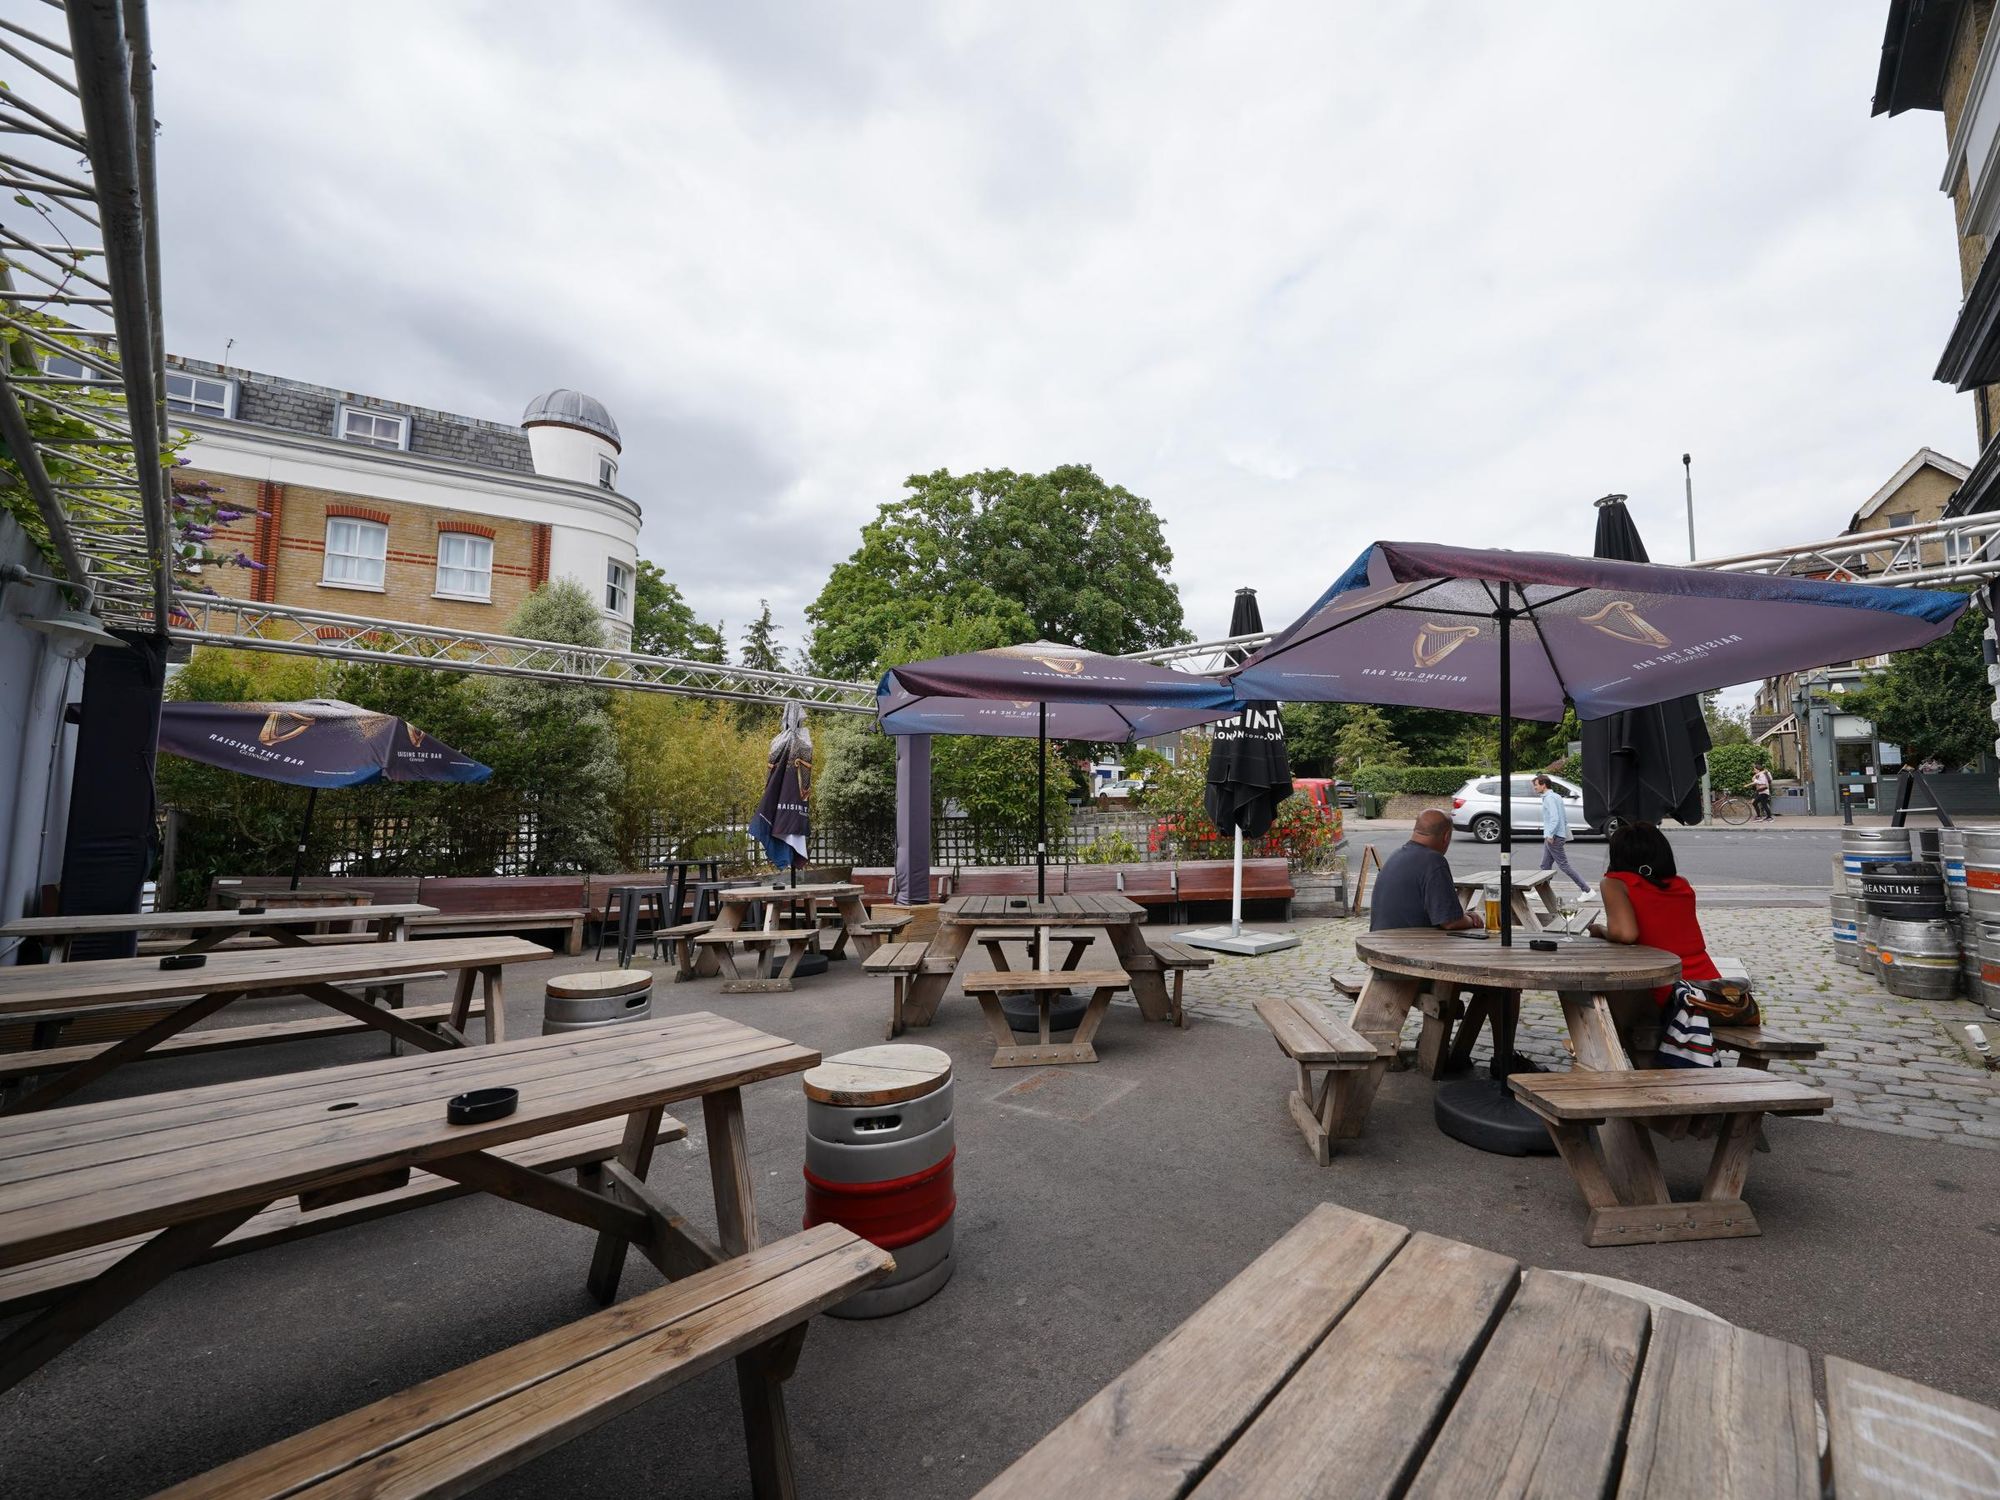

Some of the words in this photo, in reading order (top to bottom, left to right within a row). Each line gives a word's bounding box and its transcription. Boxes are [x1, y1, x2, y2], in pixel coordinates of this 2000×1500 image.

[209, 734, 256, 752] RAISING
[260, 749, 281, 760] THE
[283, 756, 305, 766] BAR
